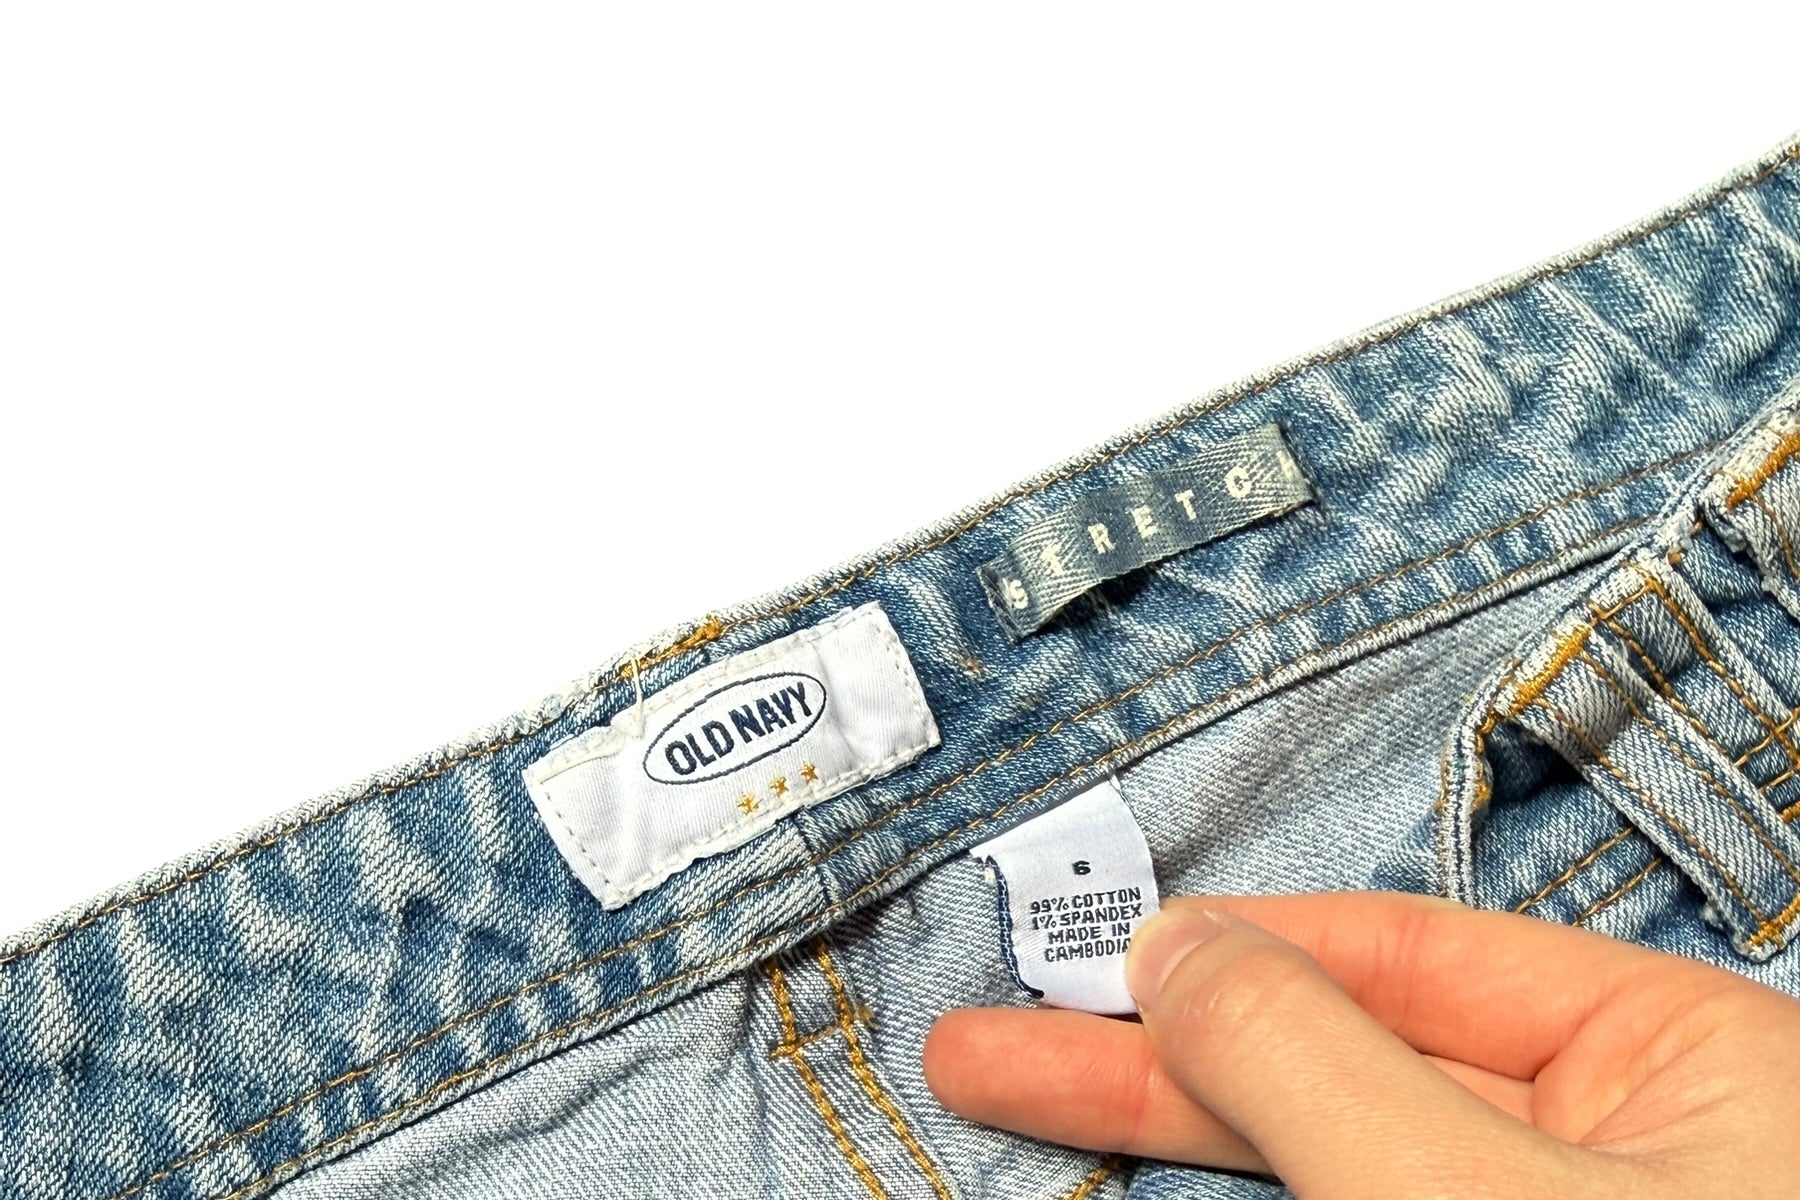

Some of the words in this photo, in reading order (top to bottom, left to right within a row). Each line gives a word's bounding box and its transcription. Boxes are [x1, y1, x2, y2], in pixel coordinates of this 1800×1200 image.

[664, 720, 734, 777] OLD
[727, 681, 811, 744] NAVY
[1071, 860, 1091, 876] 6
[1029, 896, 1070, 914] 99%
[1073, 886, 1141, 908] COTTON
[1032, 915, 1056, 930] 1%
[1059, 902, 1142, 926] SPANDEX
[1049, 925, 1101, 945] MADE
[1111, 921, 1130, 937] IN
